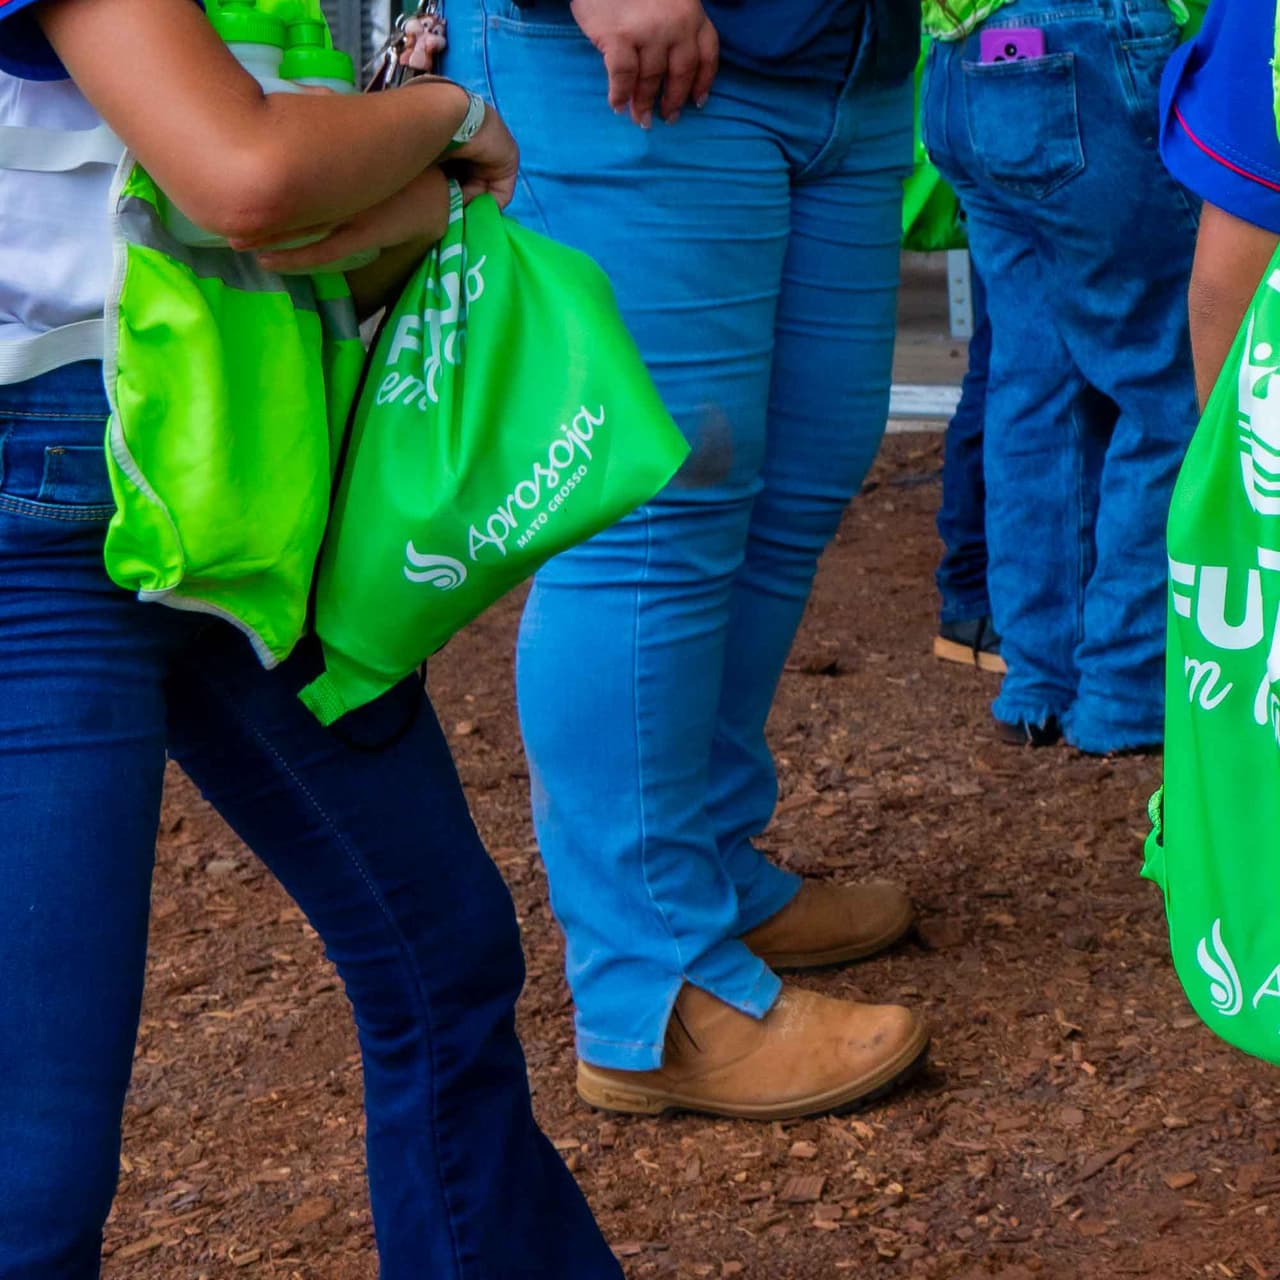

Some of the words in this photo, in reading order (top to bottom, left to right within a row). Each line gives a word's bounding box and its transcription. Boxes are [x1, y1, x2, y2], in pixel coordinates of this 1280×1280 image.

[468, 404, 606, 561] Aprosoja
[517, 512, 548, 549] MATO
[548, 464, 589, 513] GROSSO
